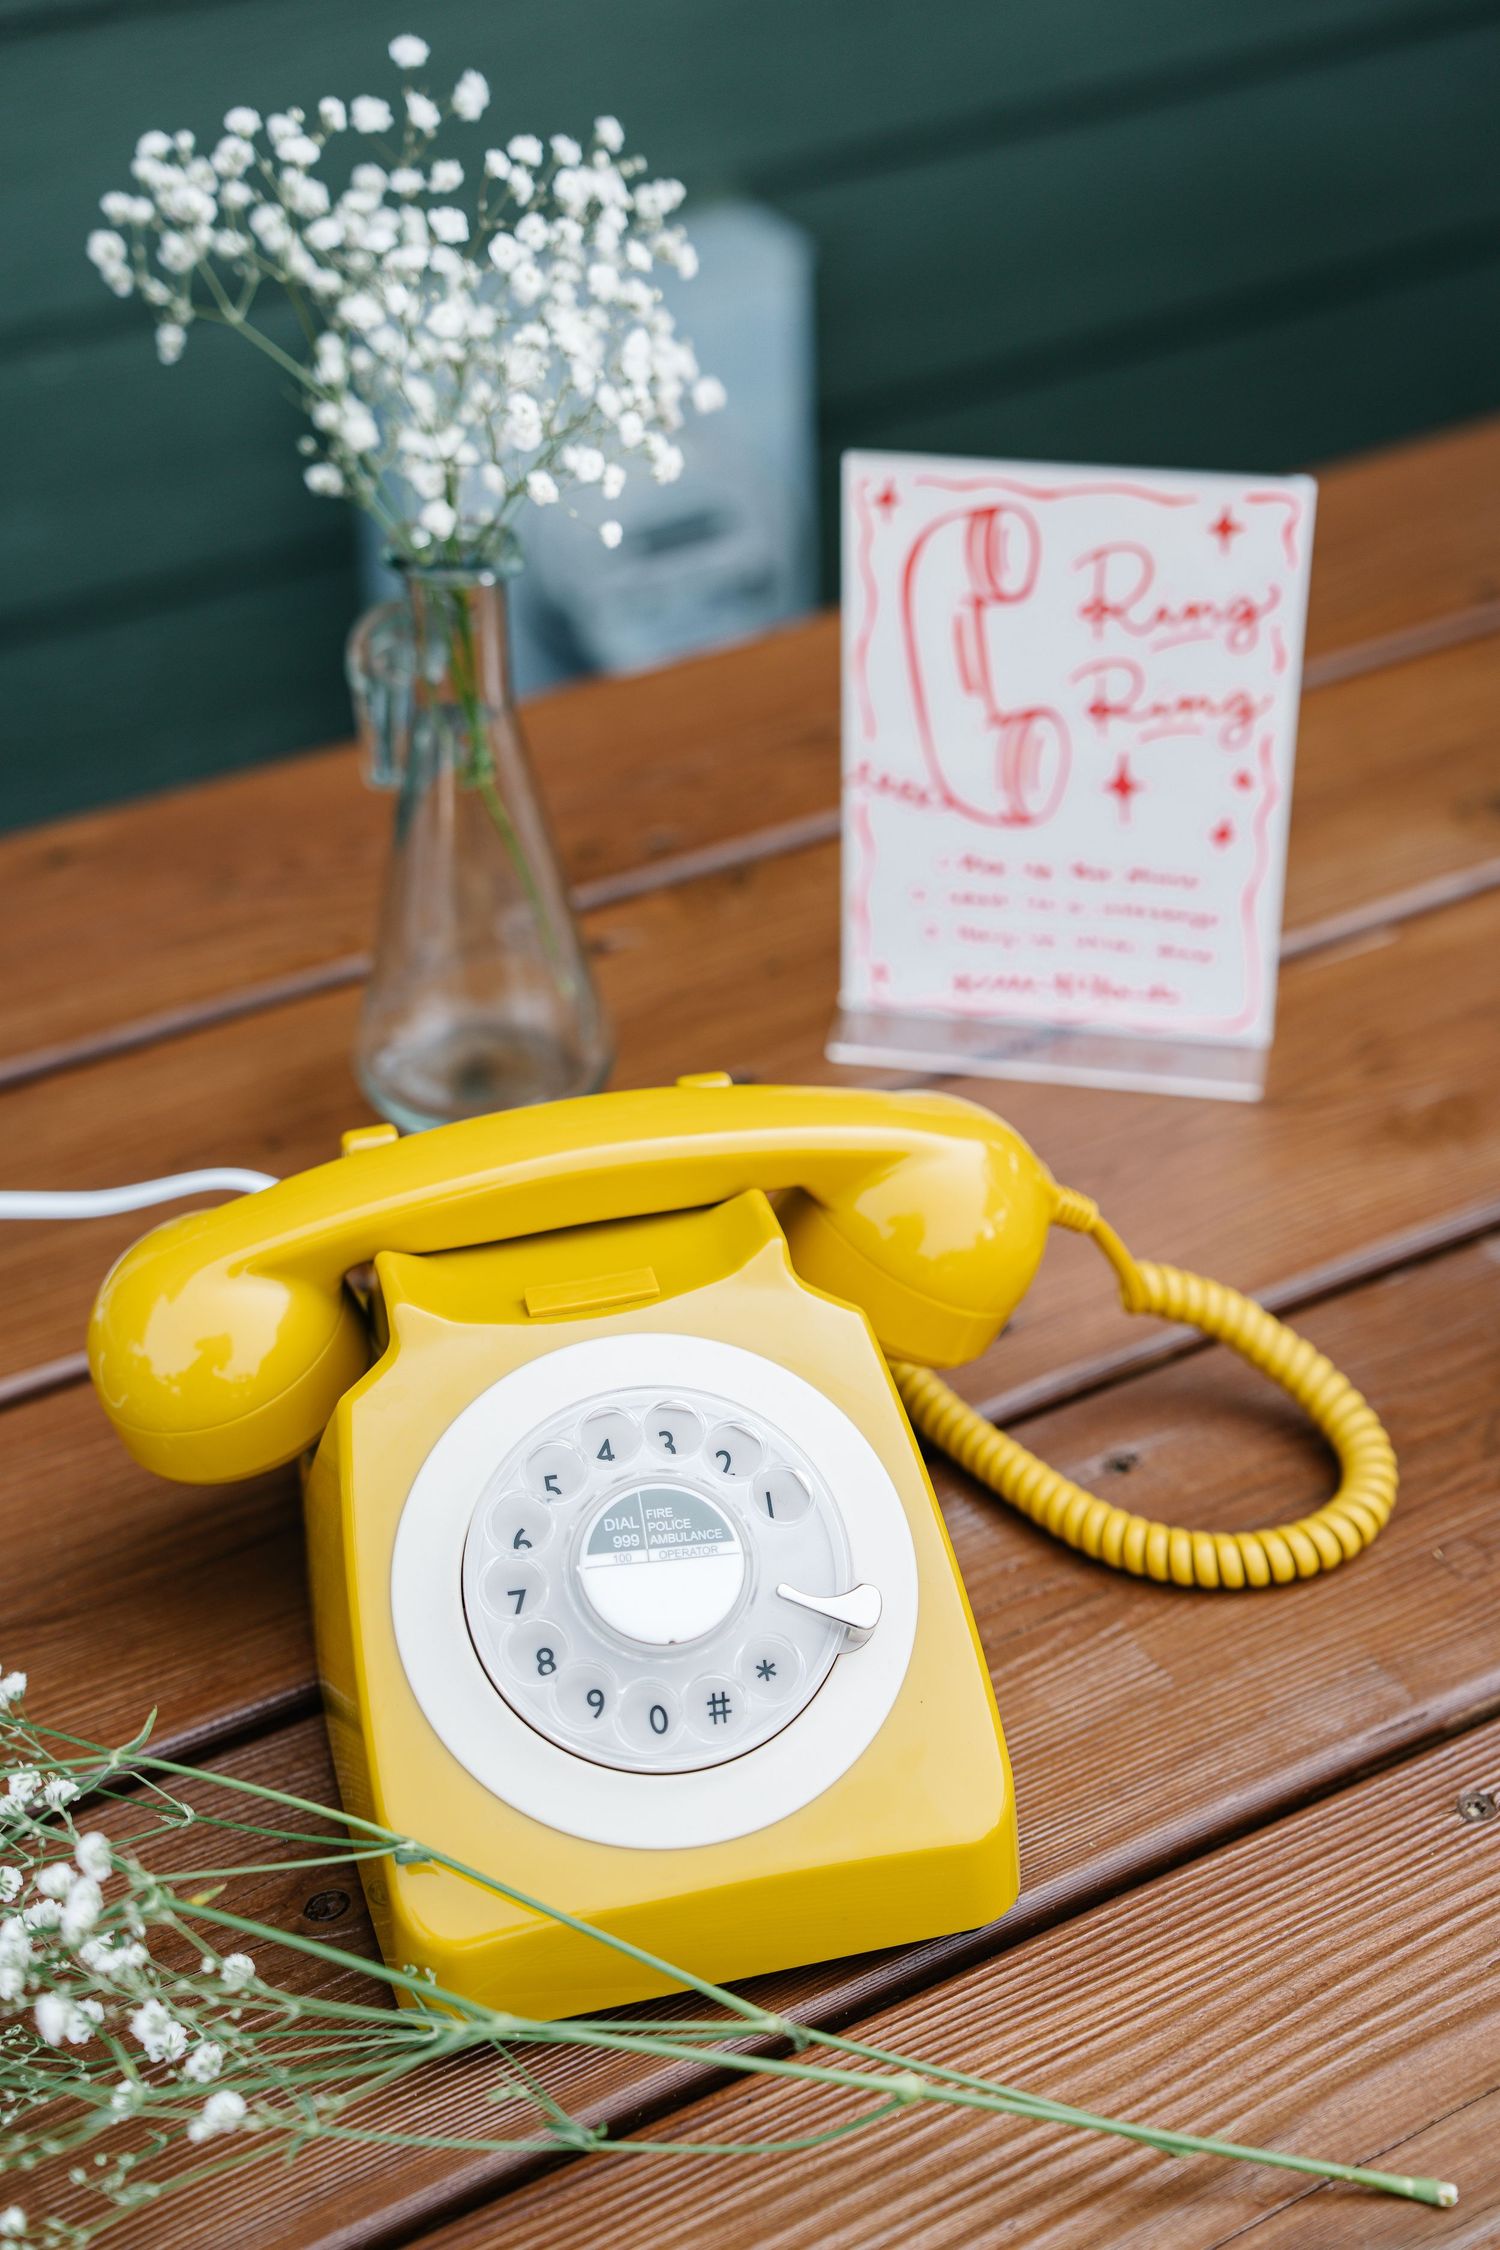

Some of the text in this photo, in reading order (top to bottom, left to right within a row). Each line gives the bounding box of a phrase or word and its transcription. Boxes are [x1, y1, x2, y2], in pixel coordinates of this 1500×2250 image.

[596, 1438, 616, 1461] 4
[658, 1430, 677, 1455] 3
[715, 1450, 736, 1476] 2
[544, 1474, 563, 1496] 5
[646, 1507, 673, 1519] FIRE
[765, 1491, 775, 1519] 1
[604, 1516, 640, 1531] DIAL
[648, 1518, 691, 1531] POLICE
[513, 1528, 533, 1550] 6
[613, 1534, 640, 1548] 999
[650, 1528, 723, 1544] AMBULANCE
[613, 1552, 632, 1563] 100
[659, 1545, 718, 1558] OPERATOR
[507, 1589, 527, 1615] 7
[536, 1647, 557, 1677] 8
[586, 1689, 605, 1719] 9
[649, 1704, 669, 1735] 0
